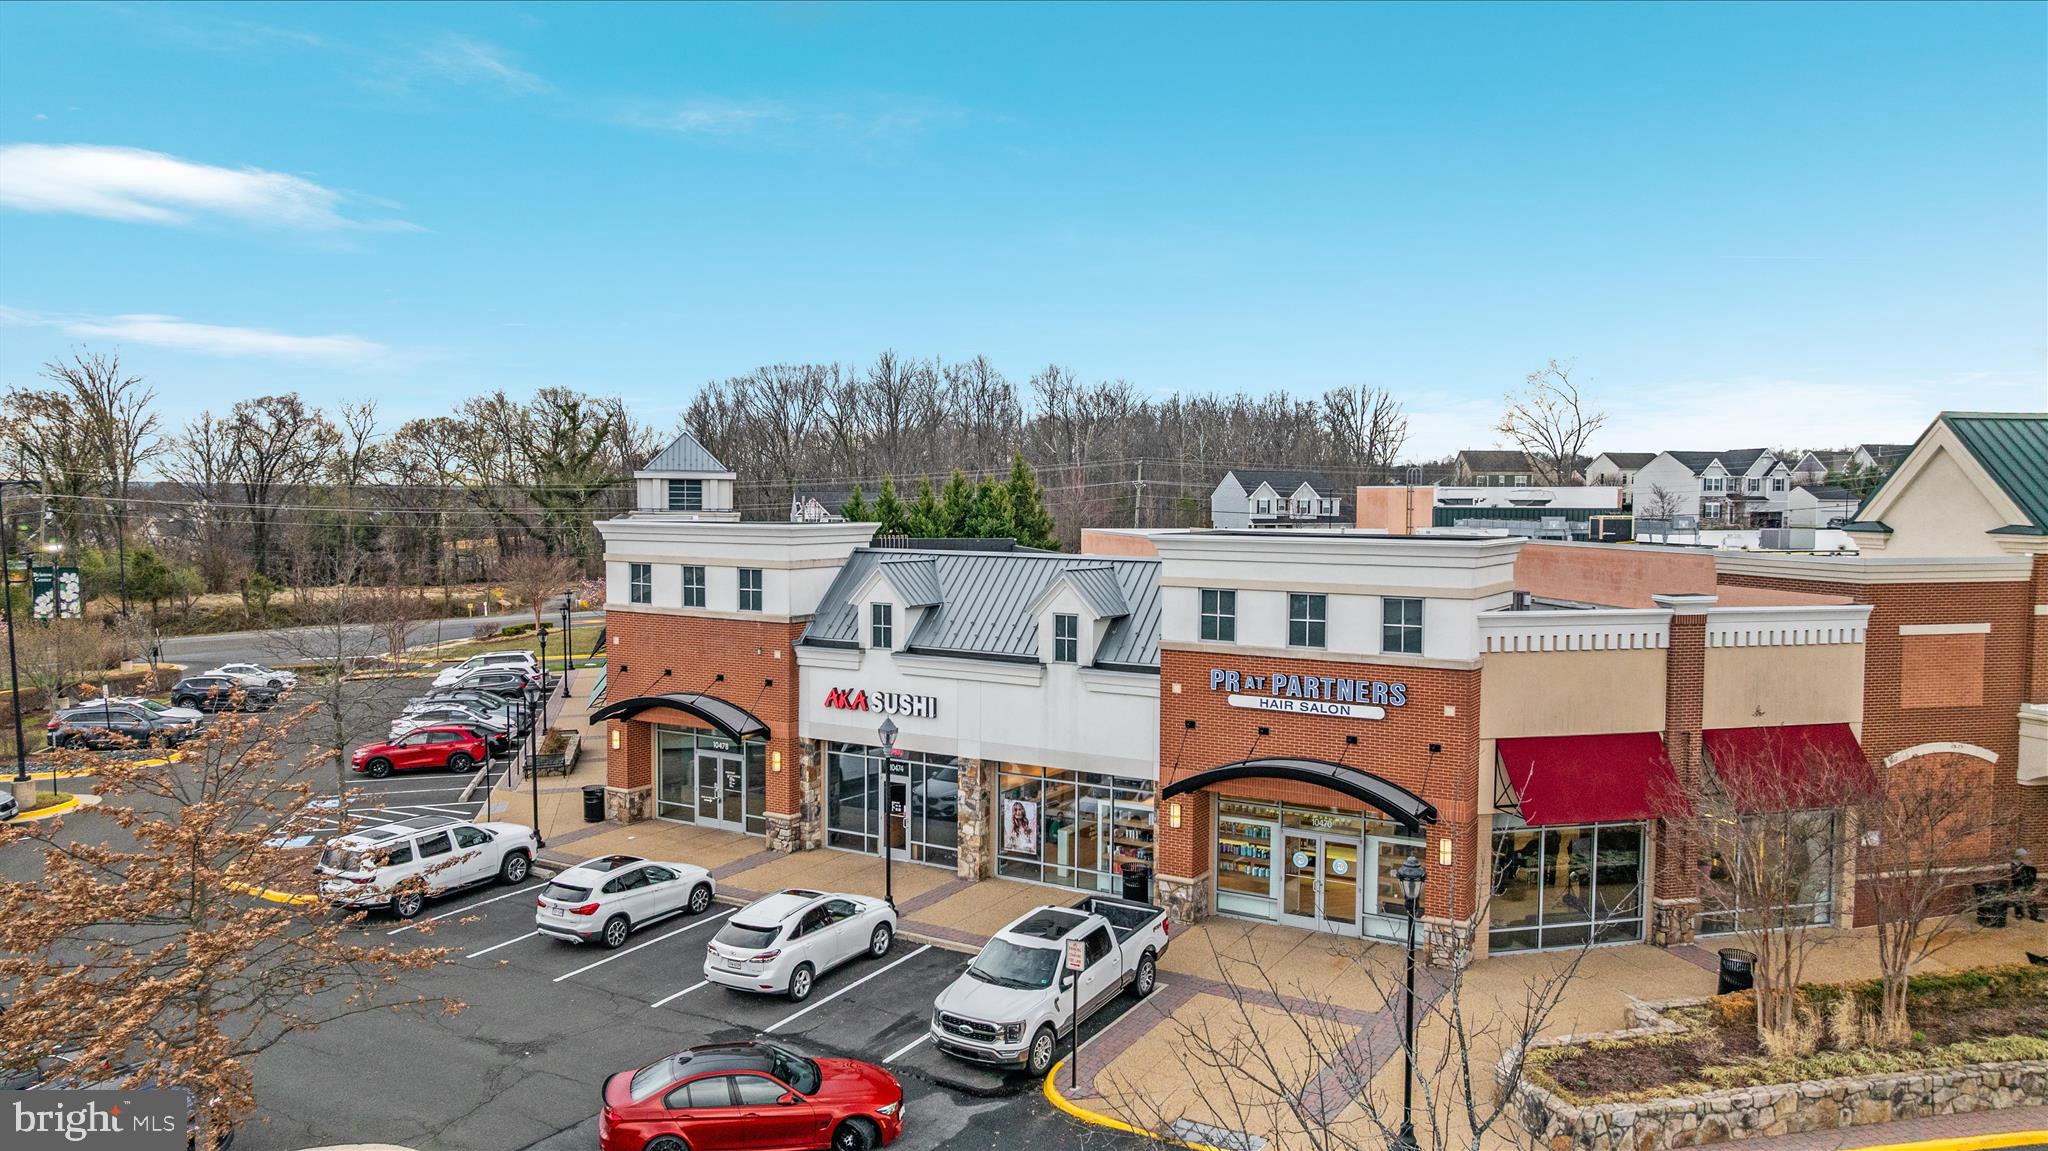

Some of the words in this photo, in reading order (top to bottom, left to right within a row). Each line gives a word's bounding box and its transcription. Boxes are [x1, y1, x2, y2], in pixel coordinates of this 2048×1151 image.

[1210, 668, 1241, 693] PR
[1244, 675, 1267, 690] AT
[1271, 672, 1408, 707] PARTNERS
[824, 687, 869, 712] AKA
[871, 691, 937, 719] SUSHI
[1259, 698, 1294, 712] HAIR
[1299, 702, 1351, 716] SALON
[712, 741, 729, 751] 10478
[1311, 818, 1333, 829] 10470
